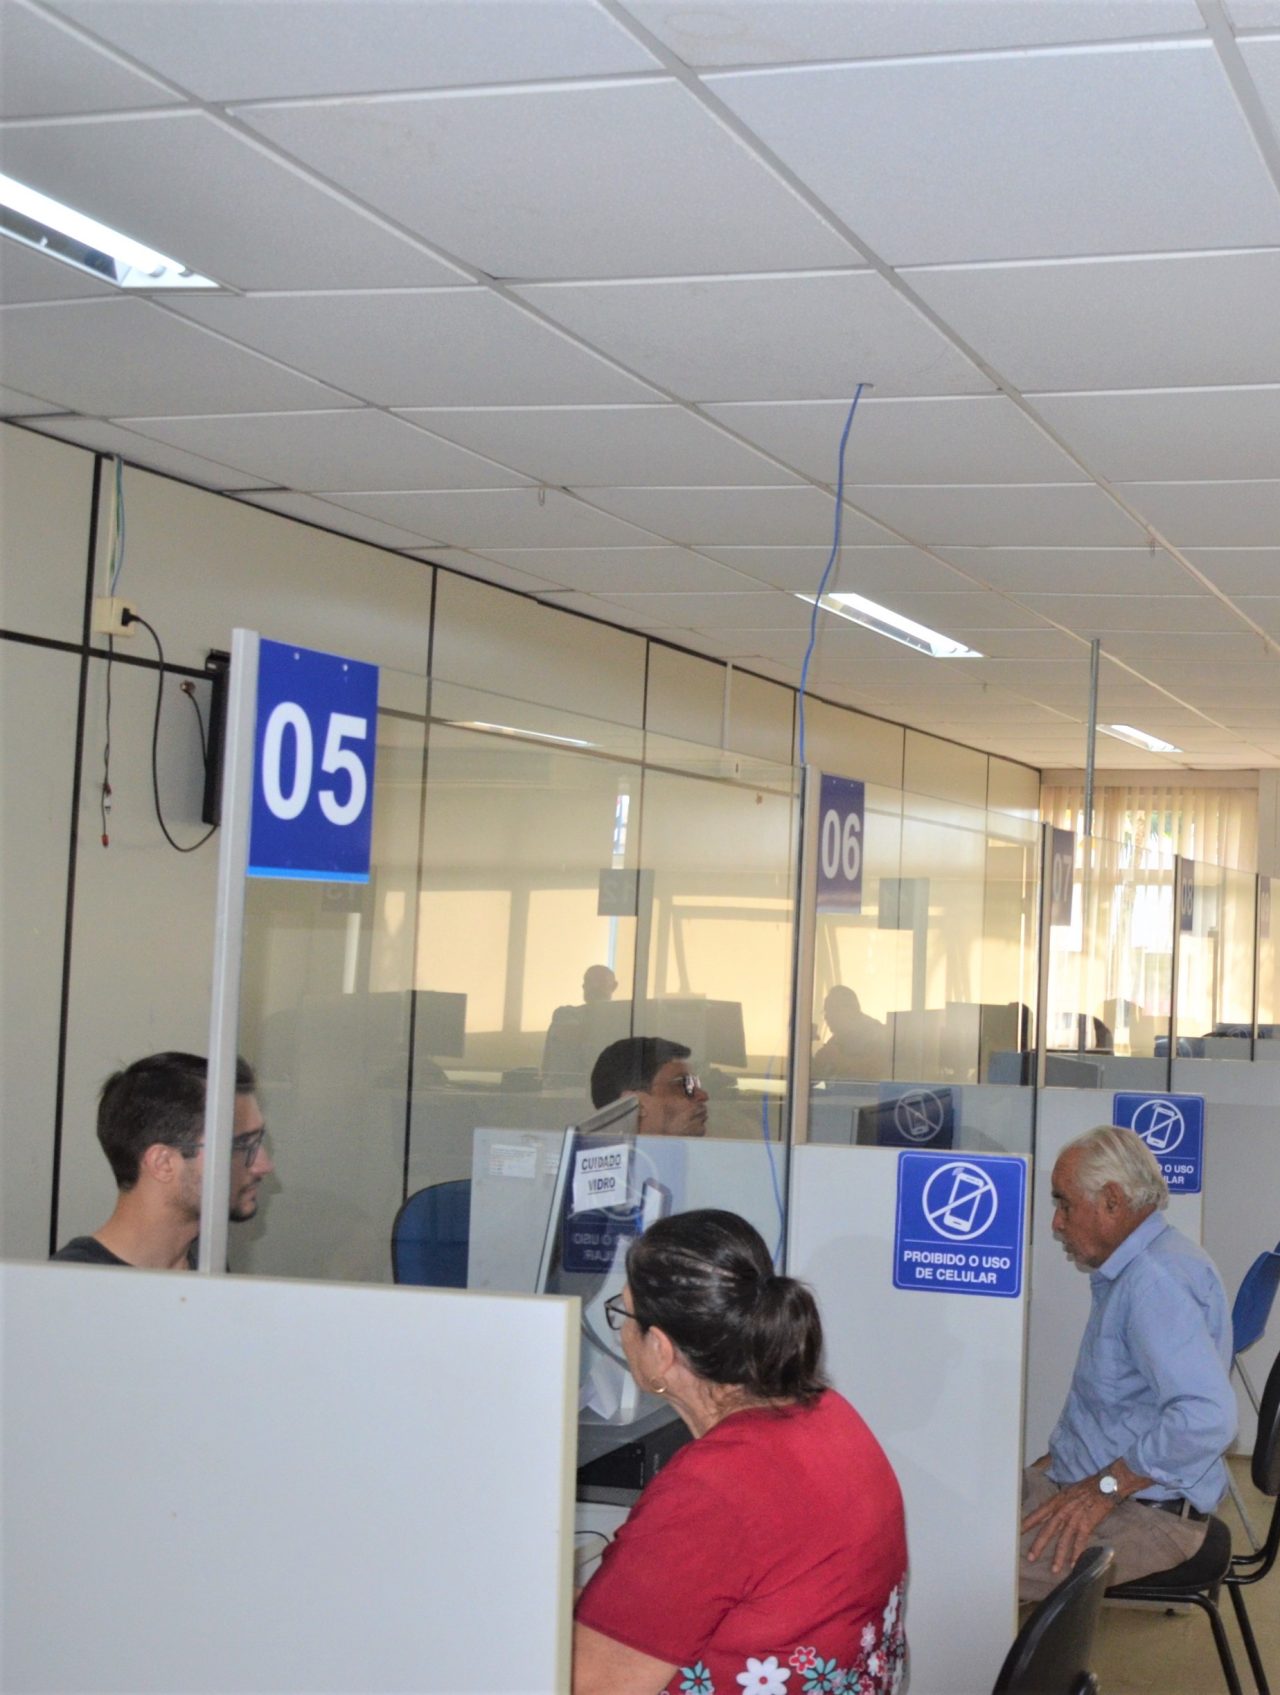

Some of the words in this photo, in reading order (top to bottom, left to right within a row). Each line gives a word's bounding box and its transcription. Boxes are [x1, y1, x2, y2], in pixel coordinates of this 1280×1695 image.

[262, 701, 367, 826] 05
[822, 809, 860, 880] 06
[1053, 853, 1072, 902] 07
[581, 1154, 621, 1170] CUIDADO
[1164, 1164, 1172, 1173] O
[1174, 1165, 1194, 1174] USO
[588, 1177, 615, 1190] VIDRO
[904, 1250, 965, 1266] PROIBIDO
[969, 1255, 979, 1267] O
[982, 1256, 1010, 1269] USO
[915, 1267, 933, 1279] DE
[936, 1269, 997, 1284] CELULAR
